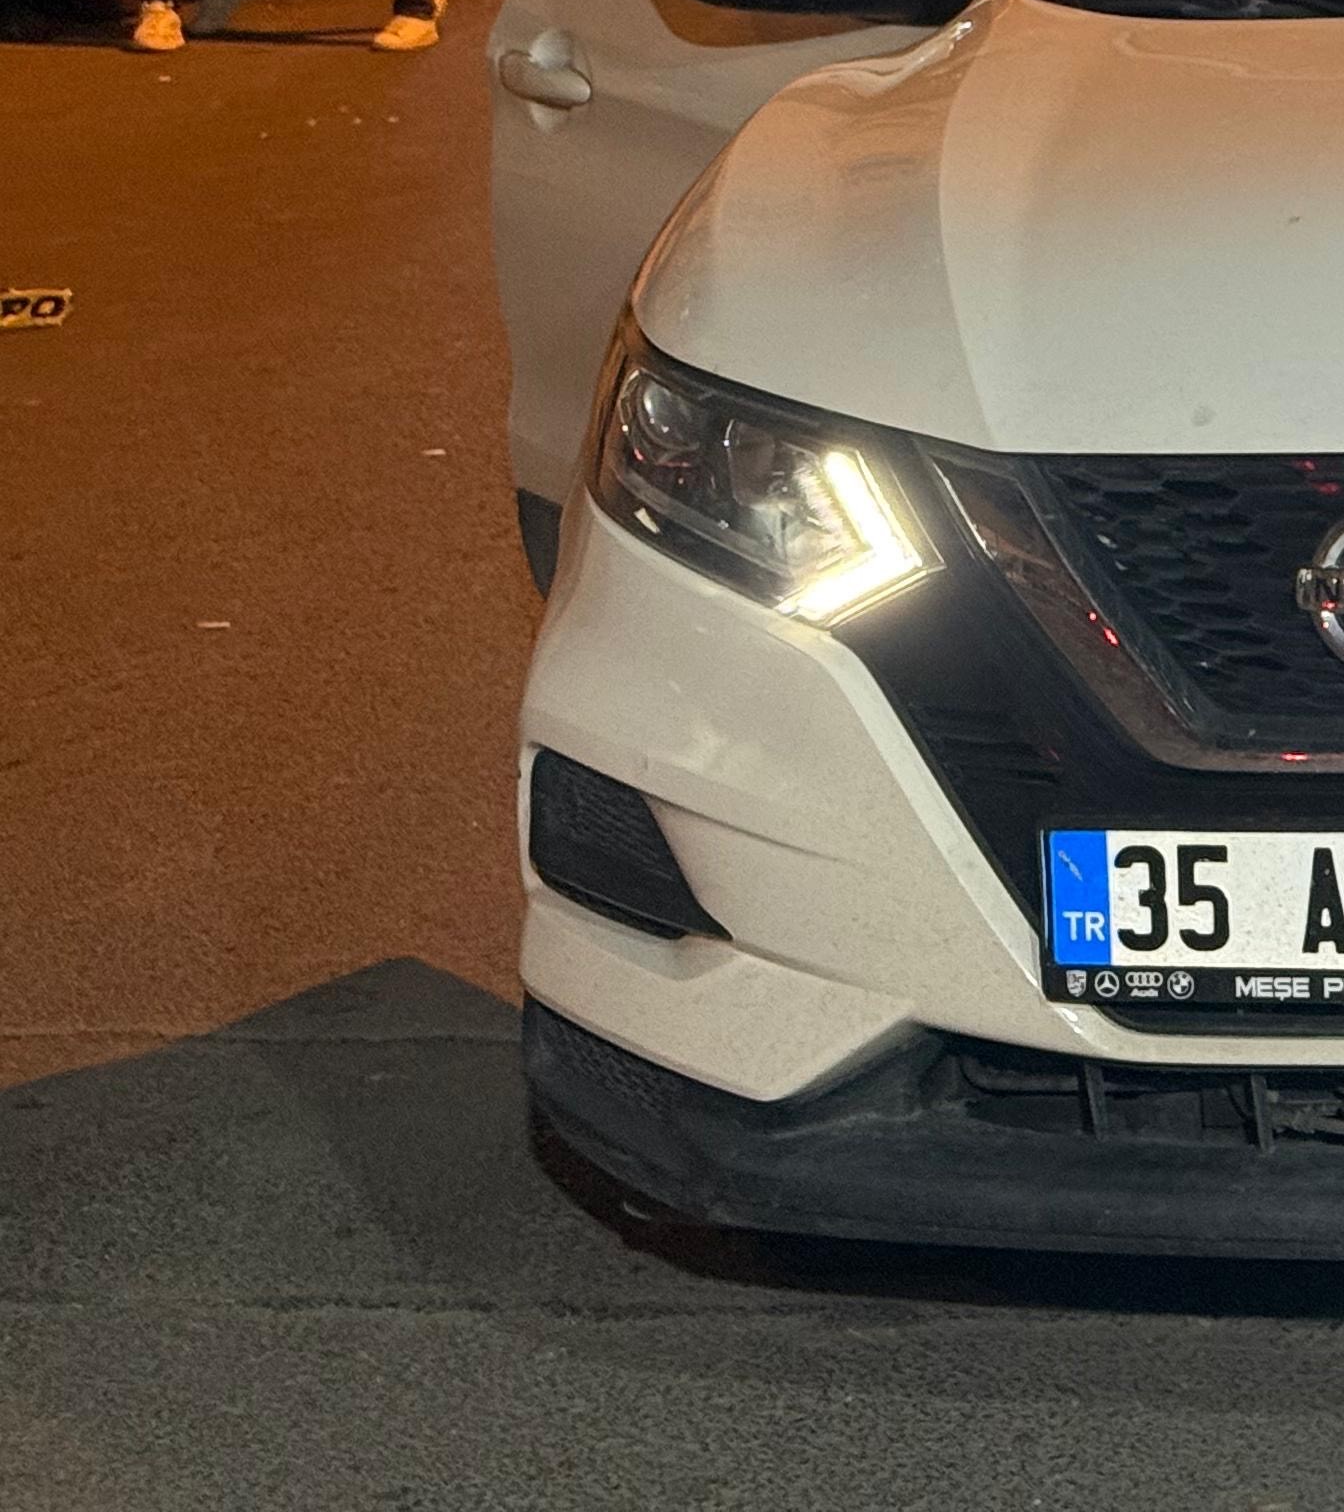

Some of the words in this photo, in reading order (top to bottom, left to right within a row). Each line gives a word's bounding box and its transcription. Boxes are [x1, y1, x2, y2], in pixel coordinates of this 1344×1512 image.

[1114, 844, 1230, 952] 35
[1062, 911, 1106, 941] TR
[1235, 976, 1310, 1001] MEŞE
